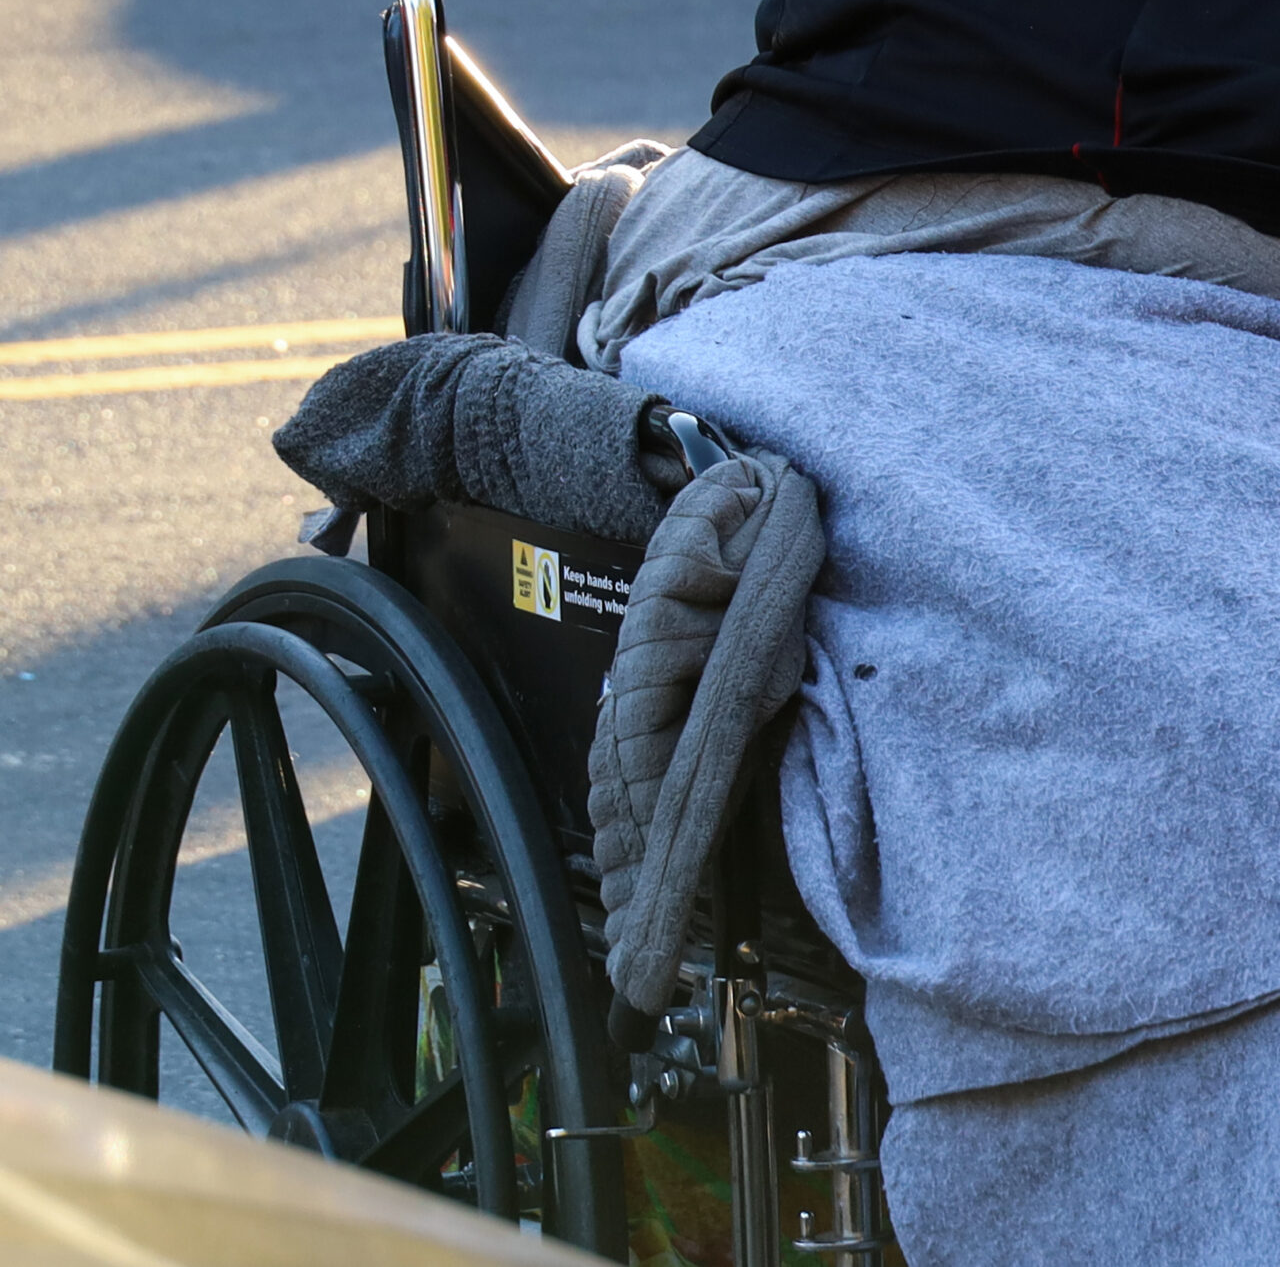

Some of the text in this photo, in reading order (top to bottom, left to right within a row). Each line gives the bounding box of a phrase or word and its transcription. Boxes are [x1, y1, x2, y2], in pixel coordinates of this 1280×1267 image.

[563, 565, 586, 587] Keep
[587, 572, 613, 591] hands
[564, 590, 603, 614] unfolding
